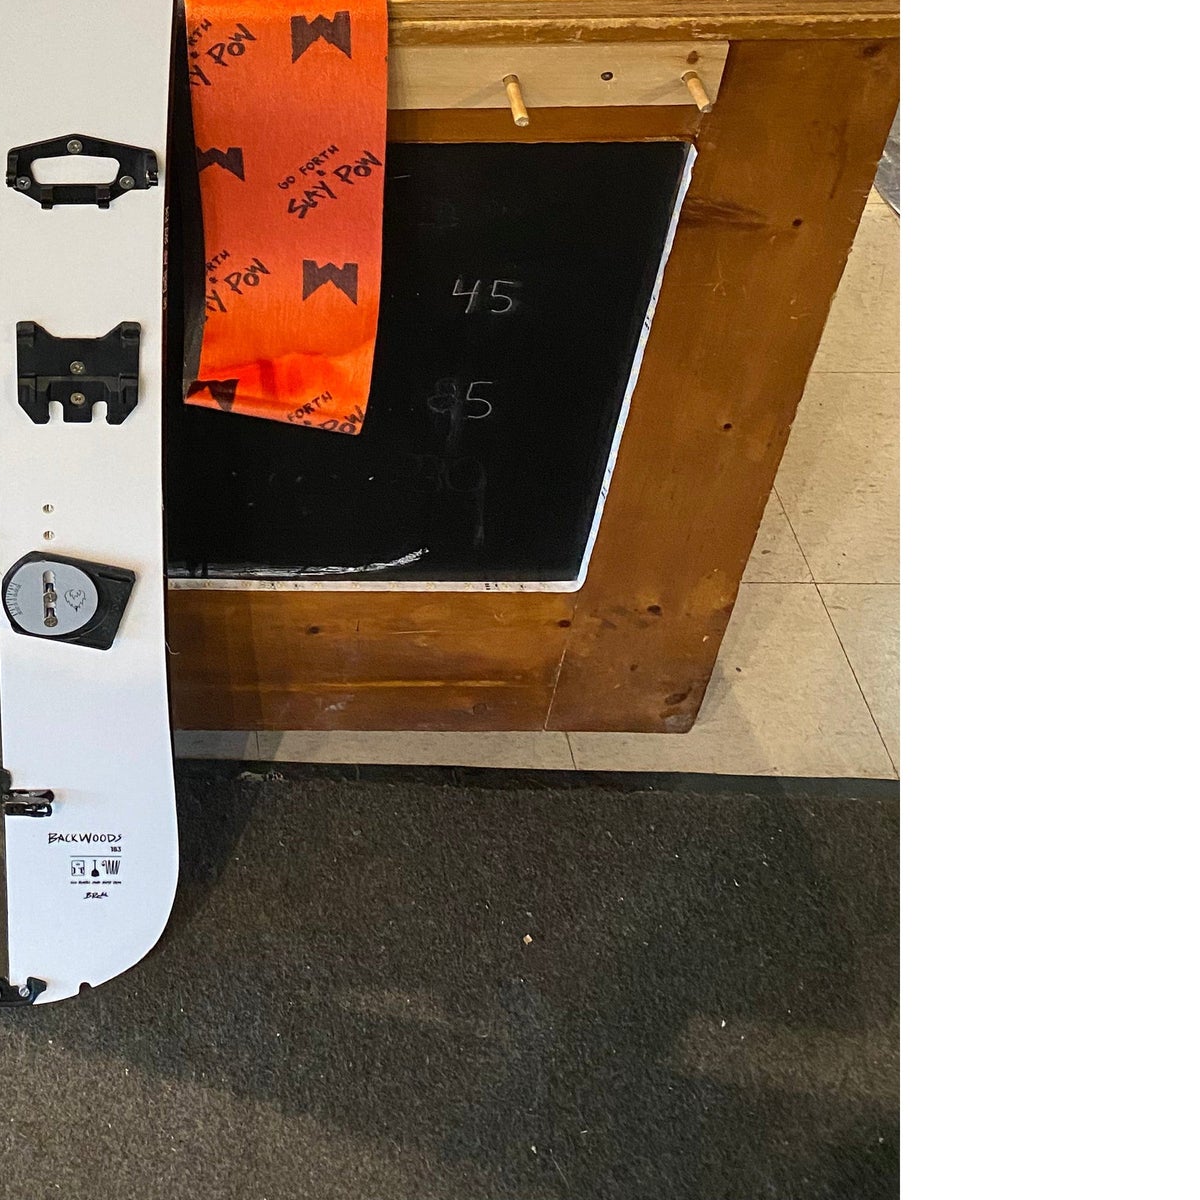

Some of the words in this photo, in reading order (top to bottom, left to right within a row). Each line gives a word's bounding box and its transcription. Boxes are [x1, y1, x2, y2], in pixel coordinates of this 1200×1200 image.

[207, 22, 257, 67] POW
[278, 175, 295, 190] GO
[299, 144, 340, 177] FORTH
[287, 179, 337, 219] SLAY
[334, 150, 383, 184] POW
[224, 257, 271, 295] POW
[451, 279, 516, 314] 45
[48, 833, 122, 844] BACKWOODS
